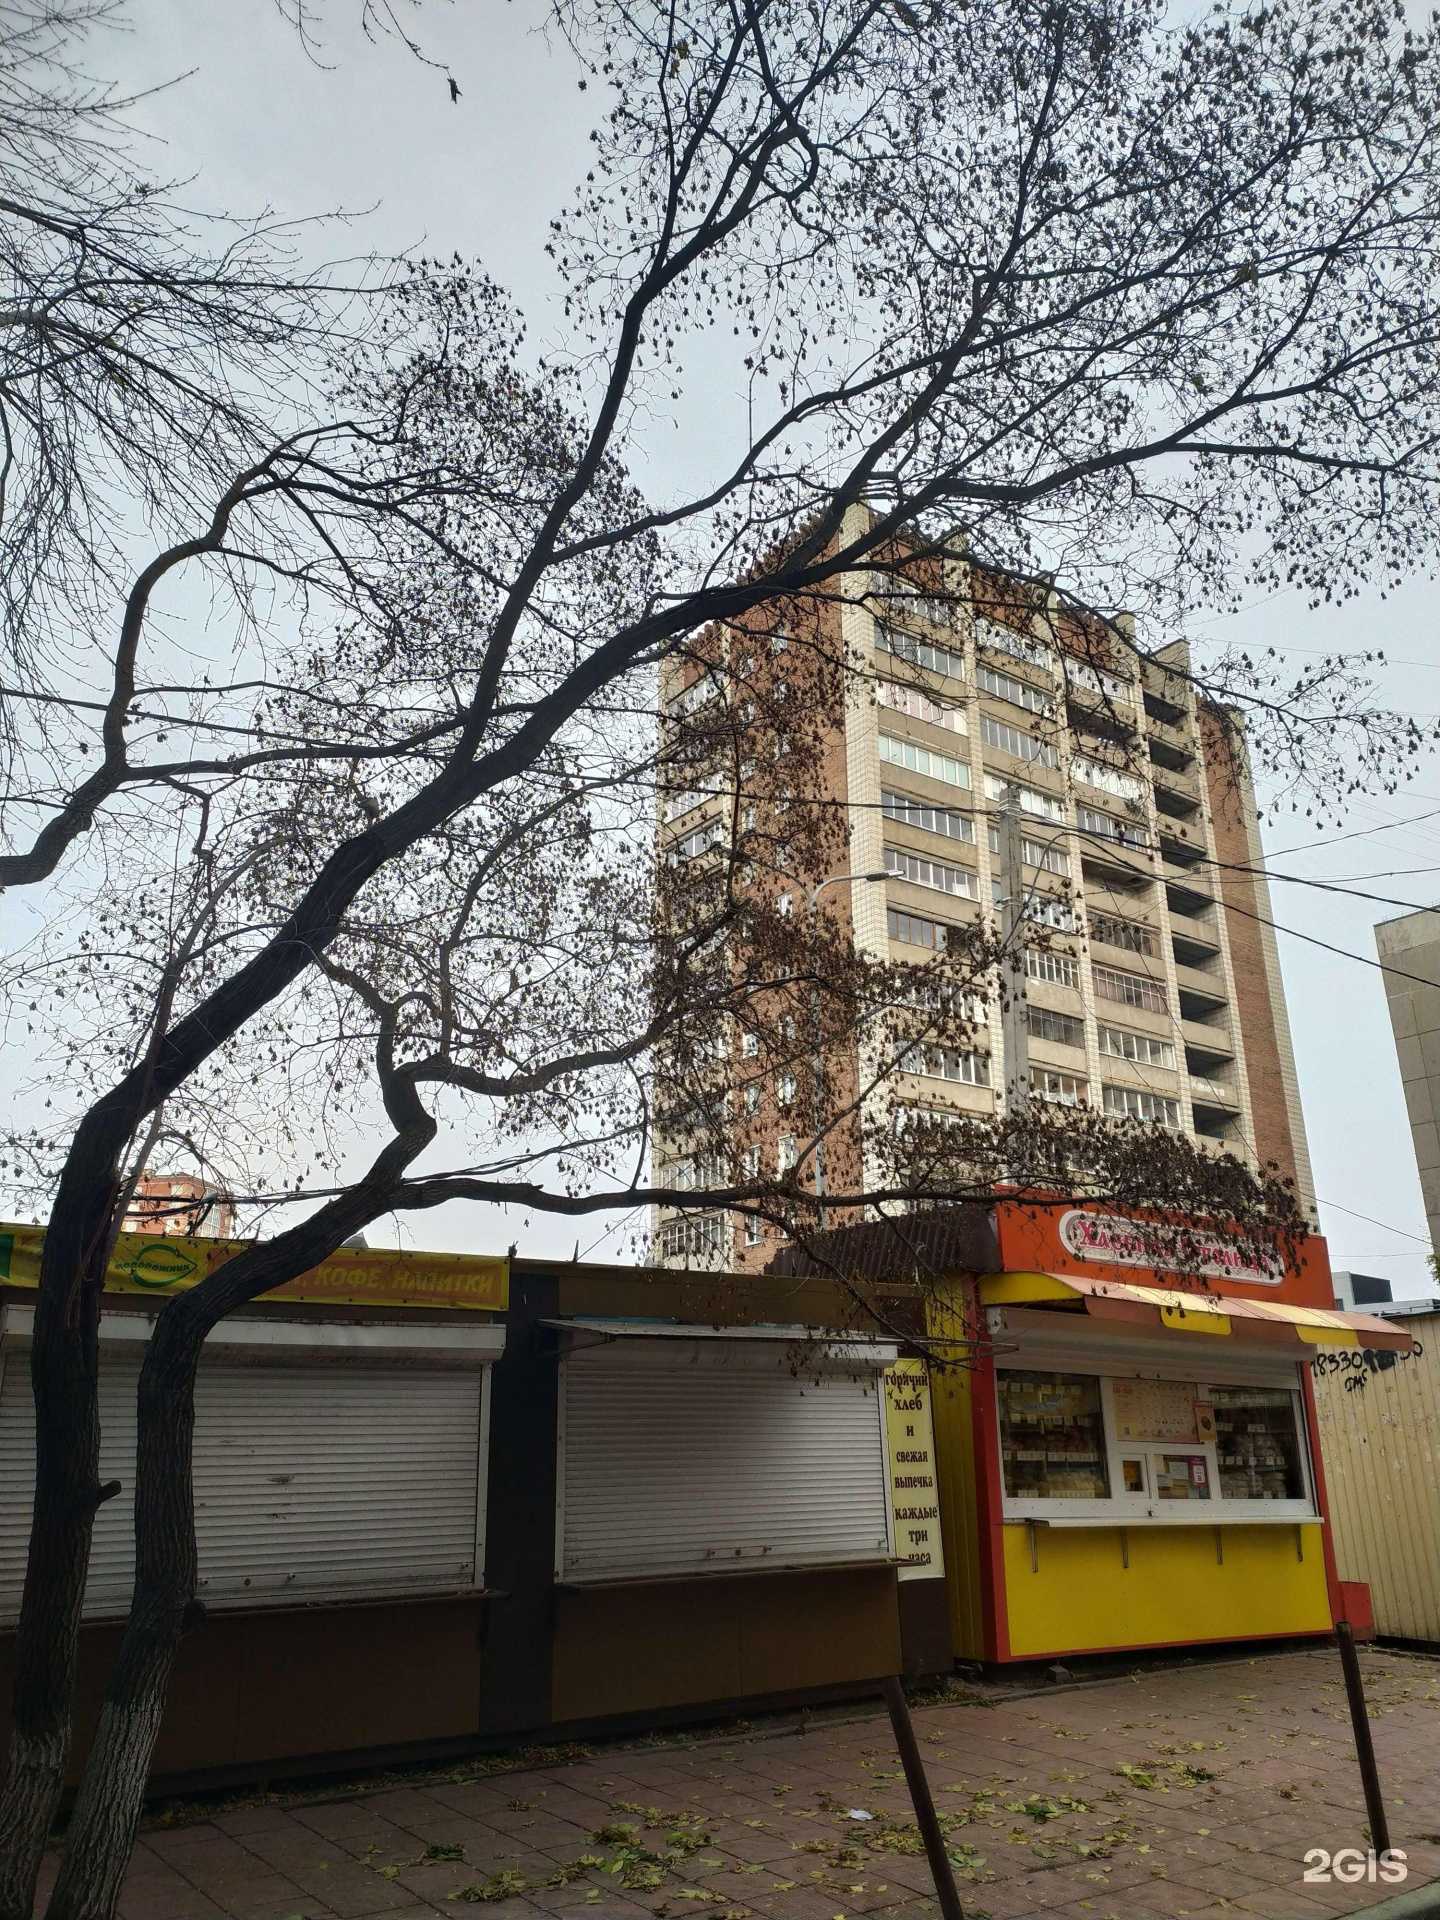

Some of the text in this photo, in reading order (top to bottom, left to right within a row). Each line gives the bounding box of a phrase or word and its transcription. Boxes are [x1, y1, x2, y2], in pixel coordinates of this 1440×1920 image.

[885, 1373, 928, 1393] горячий
[894, 1392, 922, 1410] хлеб
[906, 1424, 915, 1436] и
[896, 1450, 928, 1462] свежая
[895, 1475, 933, 1489] выпечка
[895, 1506, 938, 1520] каждые
[908, 1529, 928, 1545] три
